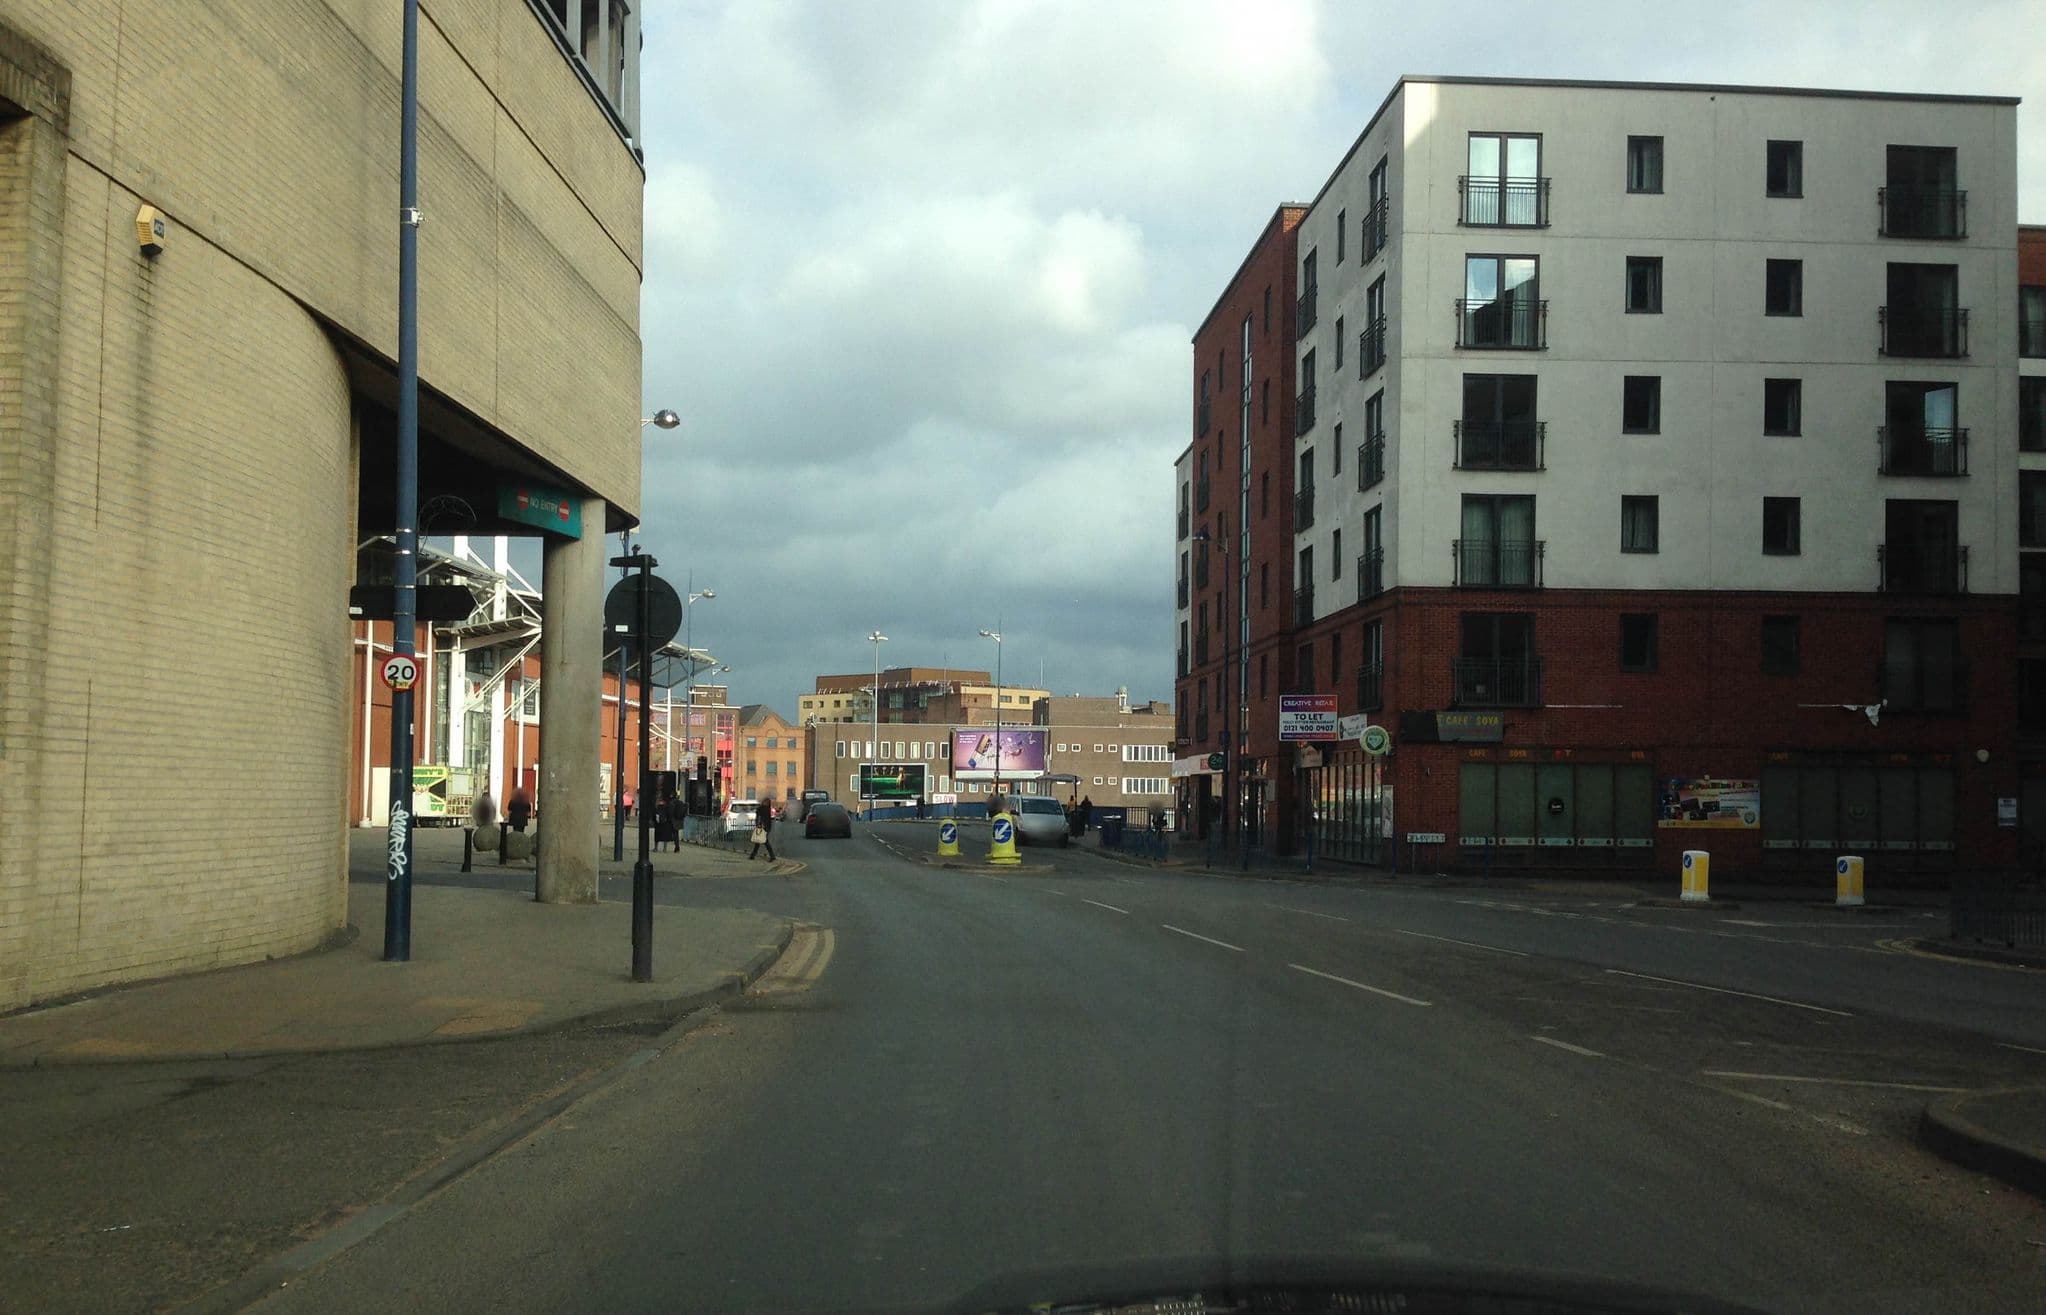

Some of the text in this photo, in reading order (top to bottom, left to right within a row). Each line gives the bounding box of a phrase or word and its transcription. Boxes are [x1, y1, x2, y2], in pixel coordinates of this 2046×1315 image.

[530, 497, 558, 513] NO ENTRY
[387, 665, 414, 680] 20
[1294, 713, 1324, 721] TO LET
[1476, 714, 1499, 726] SOYA
